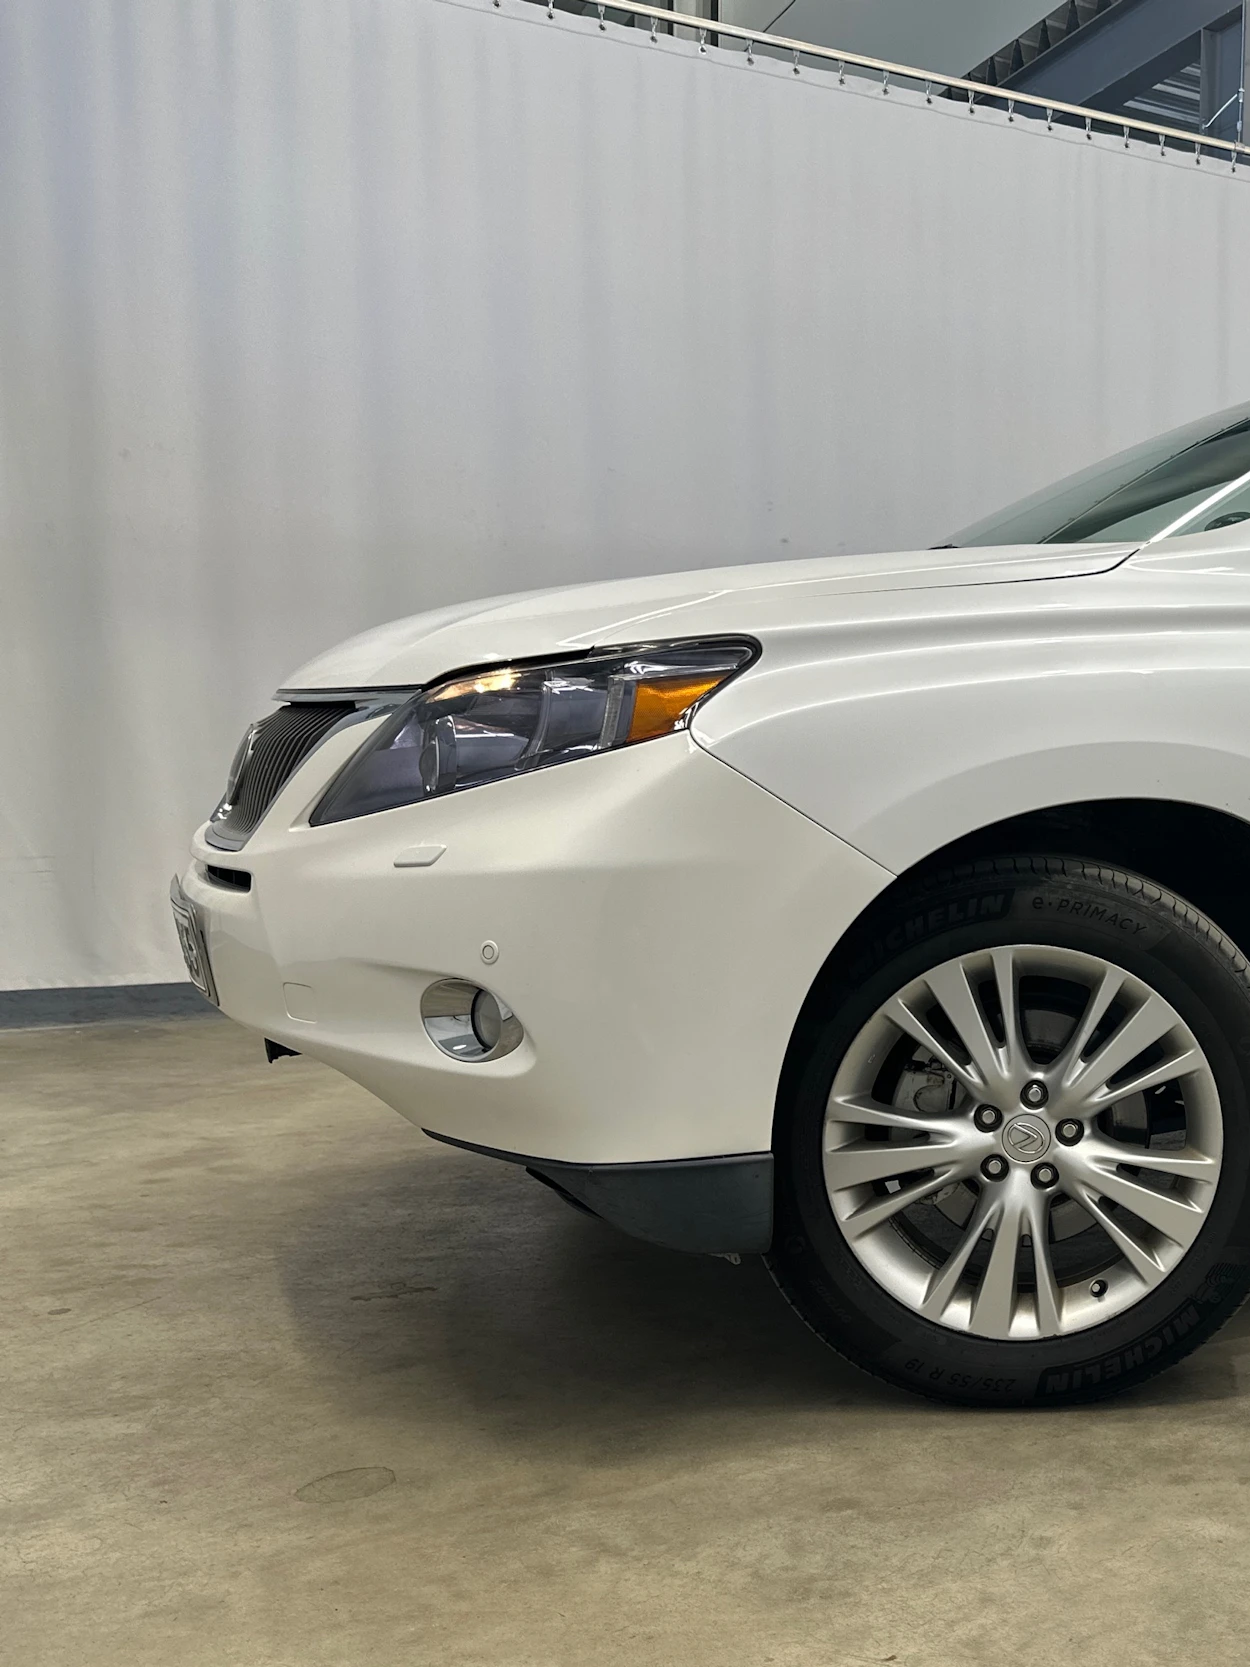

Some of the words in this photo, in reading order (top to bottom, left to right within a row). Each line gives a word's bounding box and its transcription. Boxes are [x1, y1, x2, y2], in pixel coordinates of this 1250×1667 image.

[848, 894, 1006, 981] MICHELIN
[1045, 1304, 1200, 1394] MICHELIN
[903, 1357, 925, 1375] 19
[929, 1365, 945, 1381] R
[947, 1372, 1017, 1395] 235/55
